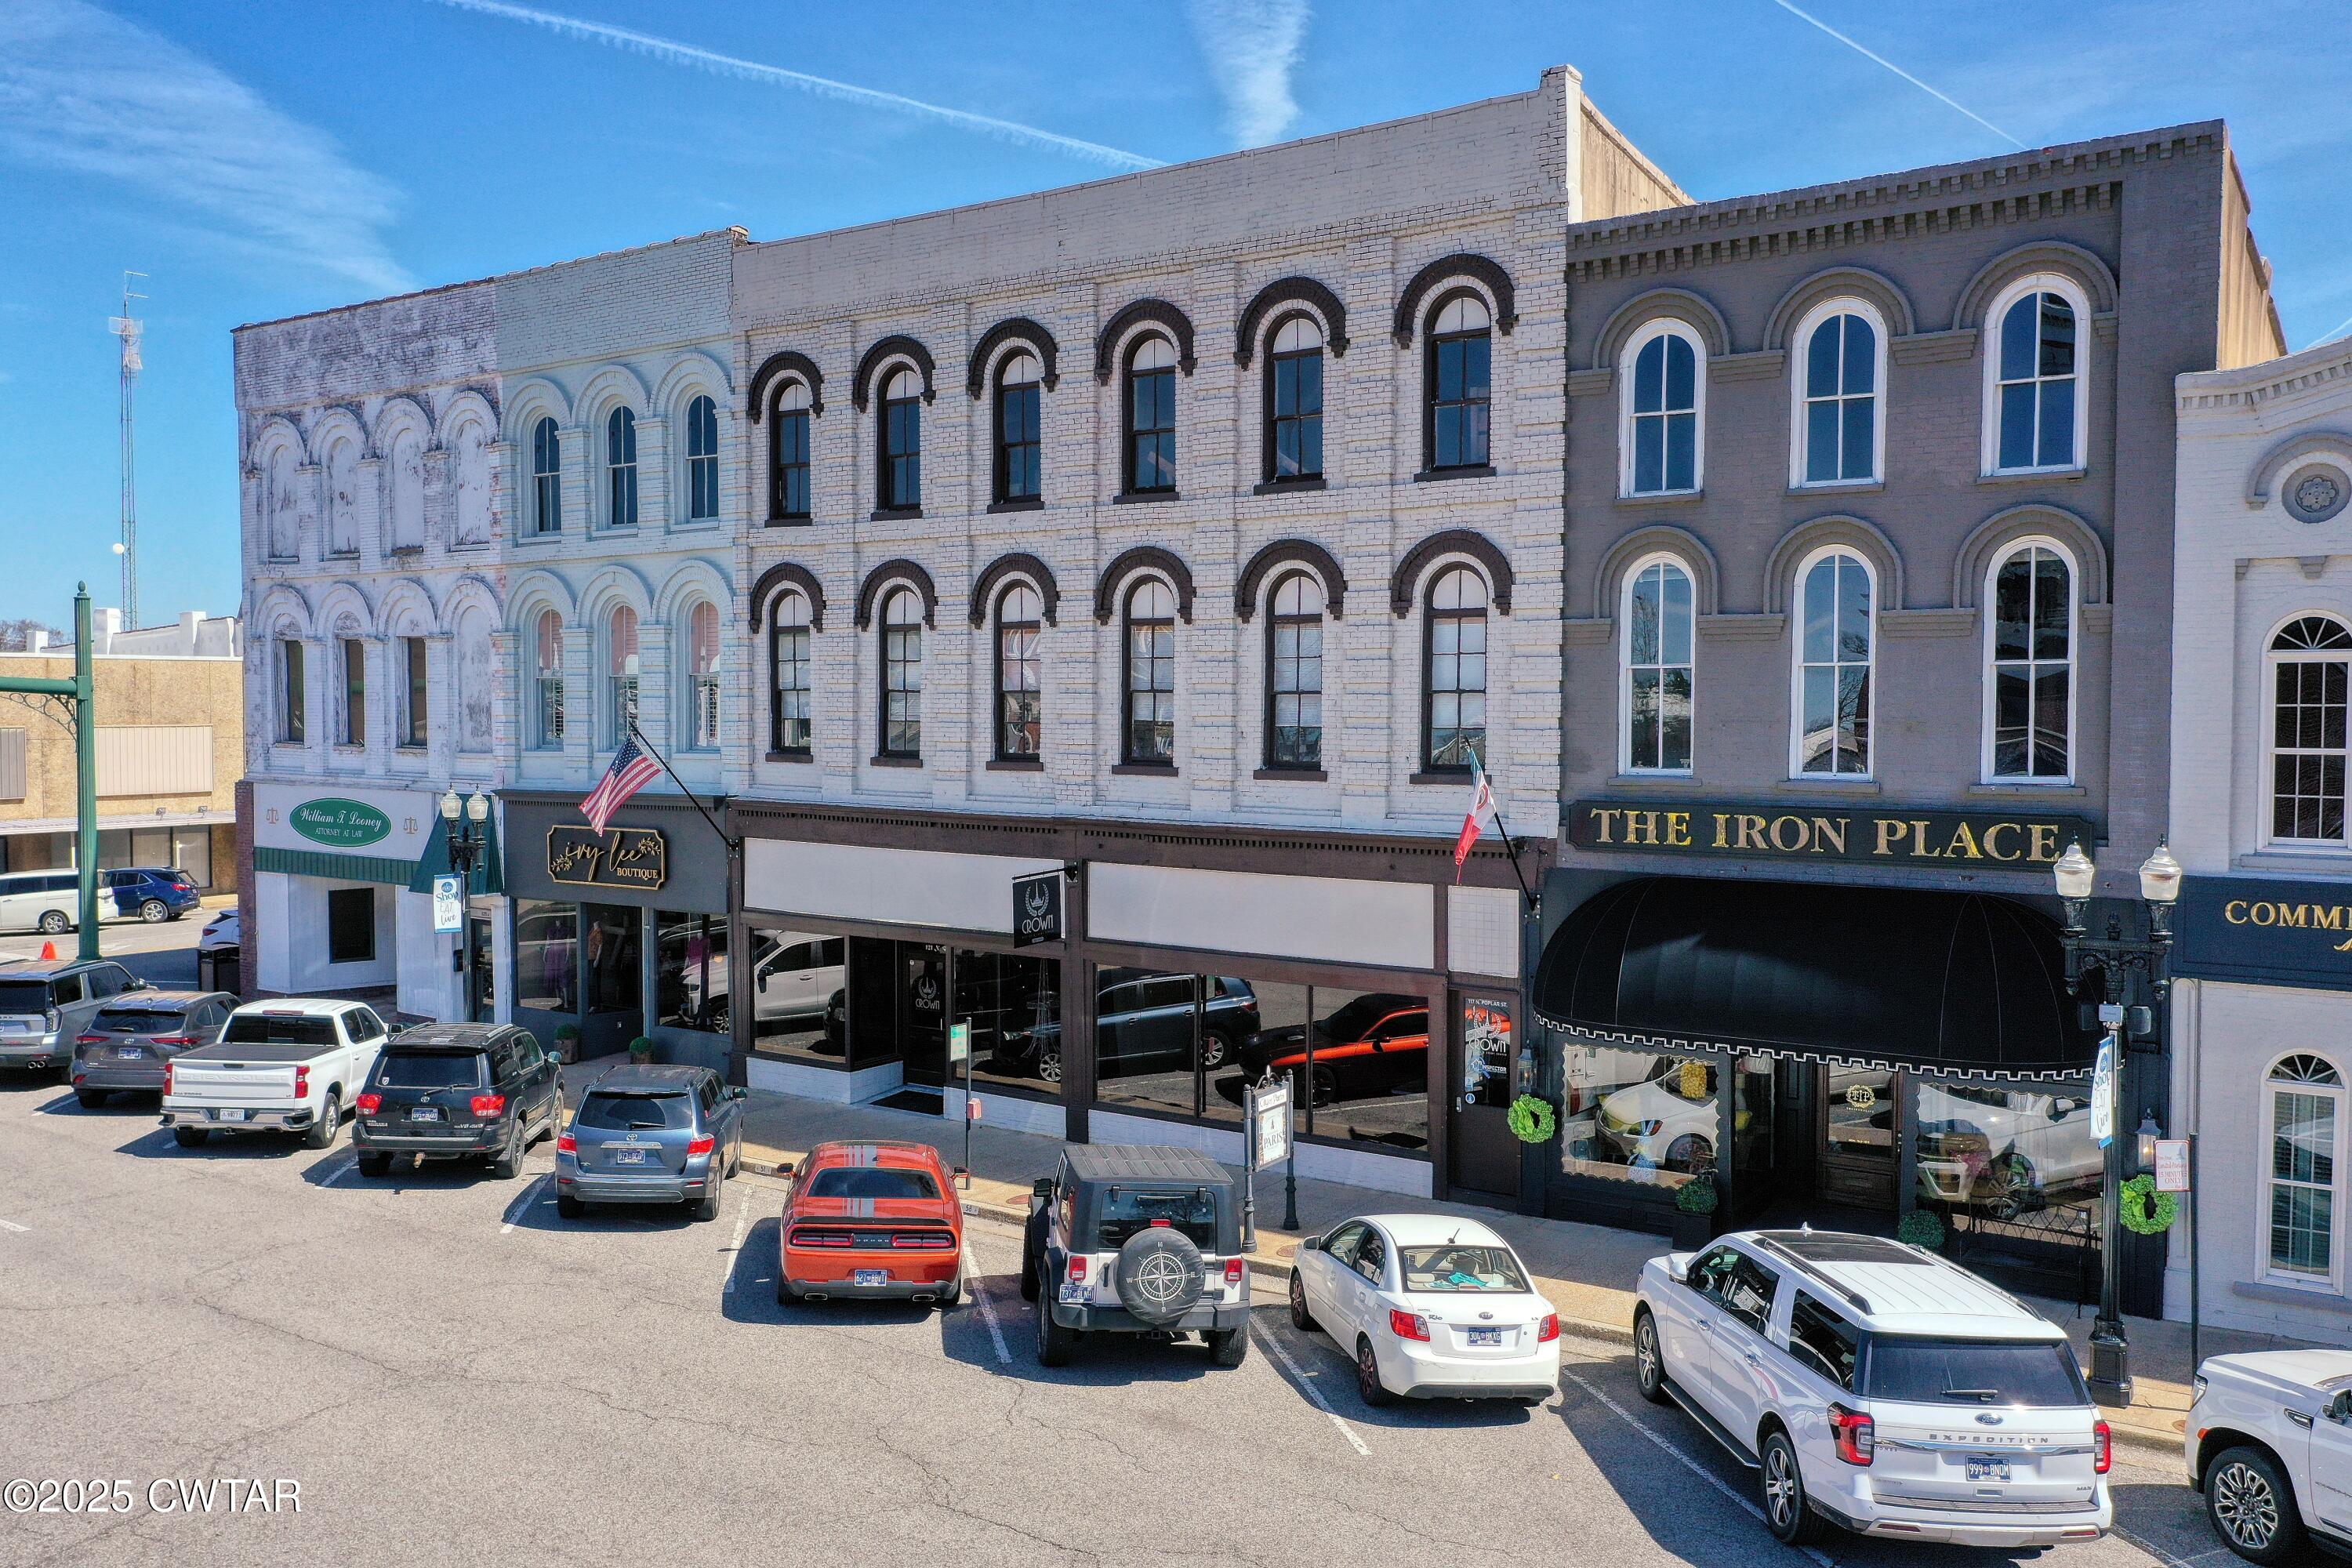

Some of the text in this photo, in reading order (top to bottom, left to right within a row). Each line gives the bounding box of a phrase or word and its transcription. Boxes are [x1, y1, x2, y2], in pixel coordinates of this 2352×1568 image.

[299, 808, 334, 823] William
[349, 811, 382, 832] Looney
[315, 827, 340, 837] ATTORNEY
[1591, 808, 2060, 862] THE IRON PLACE
[566, 832, 642, 881] ivy lee
[617, 868, 658, 881] BOUTIQUE
[436, 891, 459, 902] Shop
[440, 902, 455, 914] EAT
[1022, 914, 1054, 934] CROWN
[915, 998, 940, 1011] CROWN
[1468, 1038, 1506, 1052] CROWN
[179, 1073, 287, 1083] CHEVROLET
[1264, 1131, 1283, 1149] PARIS
[1061, 1288, 1073, 1298] 737
[1469, 1331, 1501, 1341] 304 BKXG
[1981, 1414, 1996, 1424] Ford
[1929, 1433, 2049, 1444] EXPEDITION
[1969, 1463, 1984, 1475] 999
